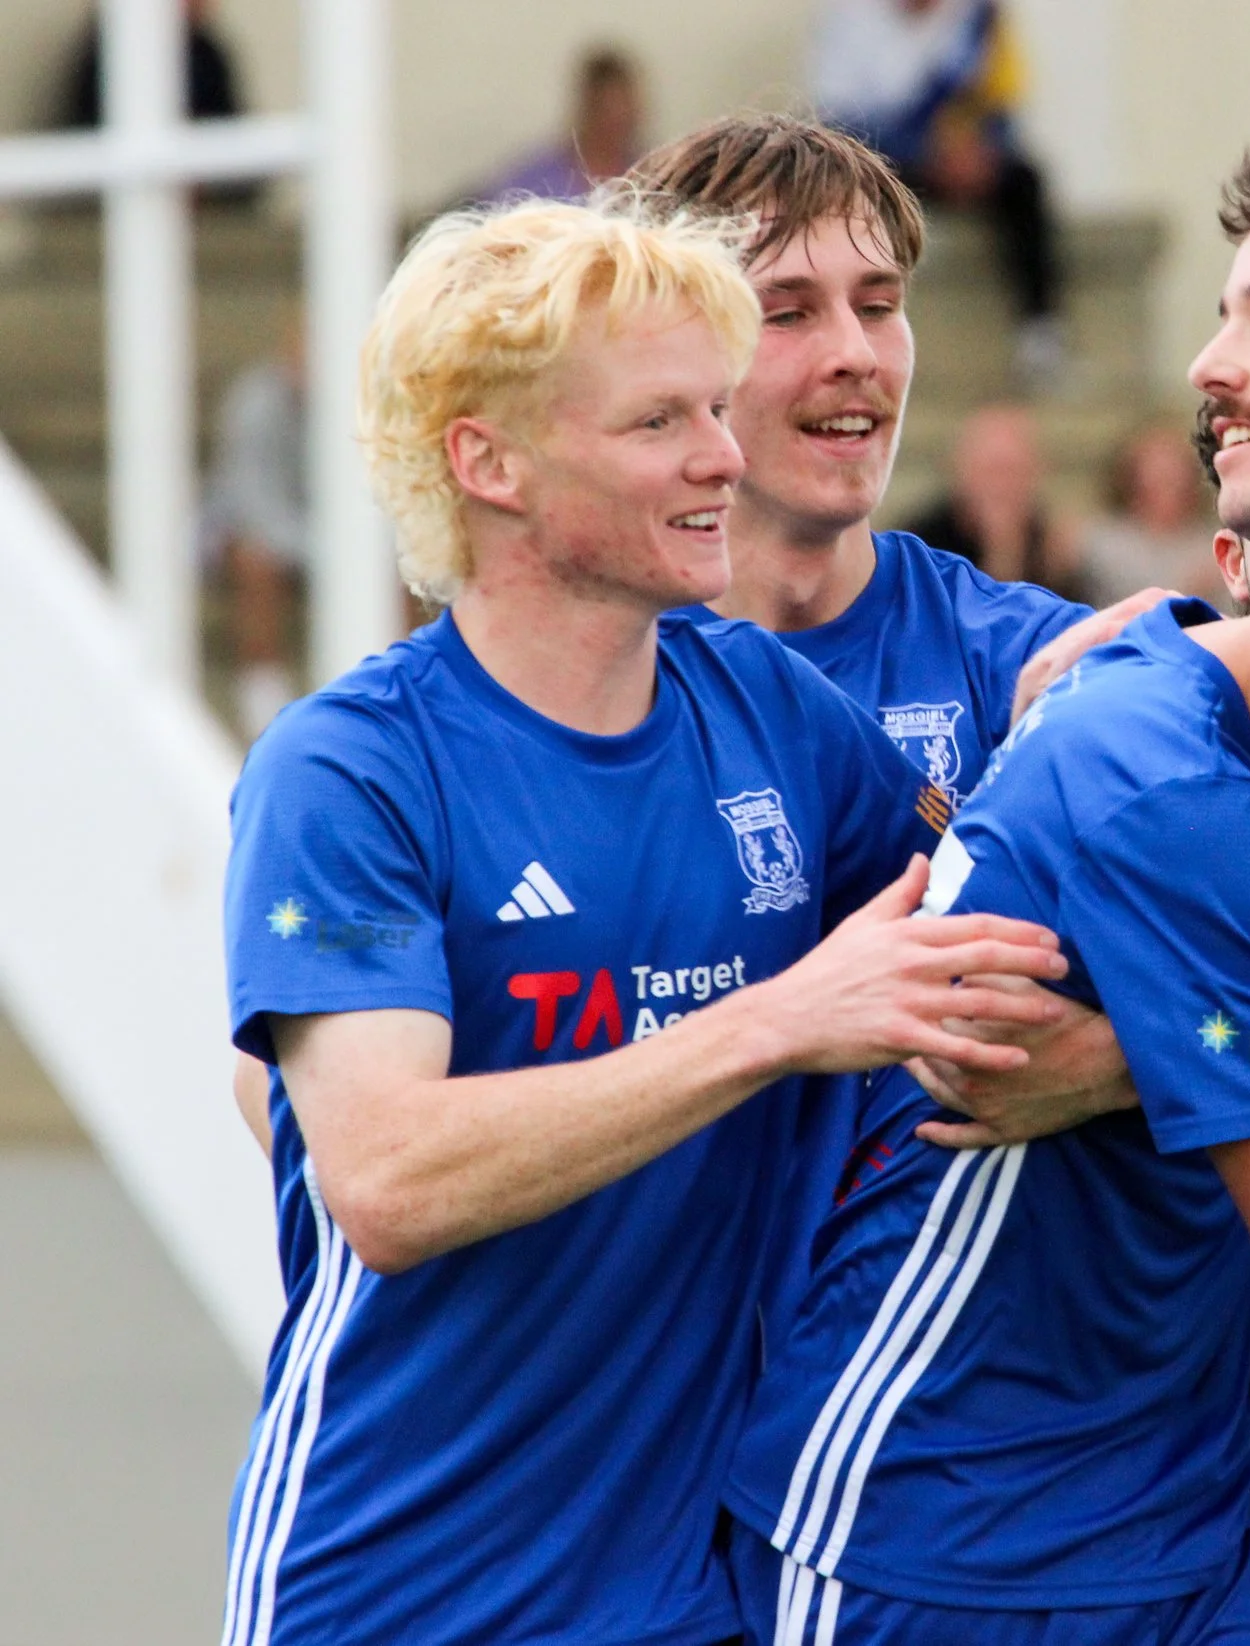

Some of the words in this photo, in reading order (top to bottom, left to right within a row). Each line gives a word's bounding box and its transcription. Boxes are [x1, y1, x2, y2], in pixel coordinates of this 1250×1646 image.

[885, 709, 949, 726] MOSGIEL
[631, 955, 746, 1001] Target
[507, 967, 624, 1051] TA
